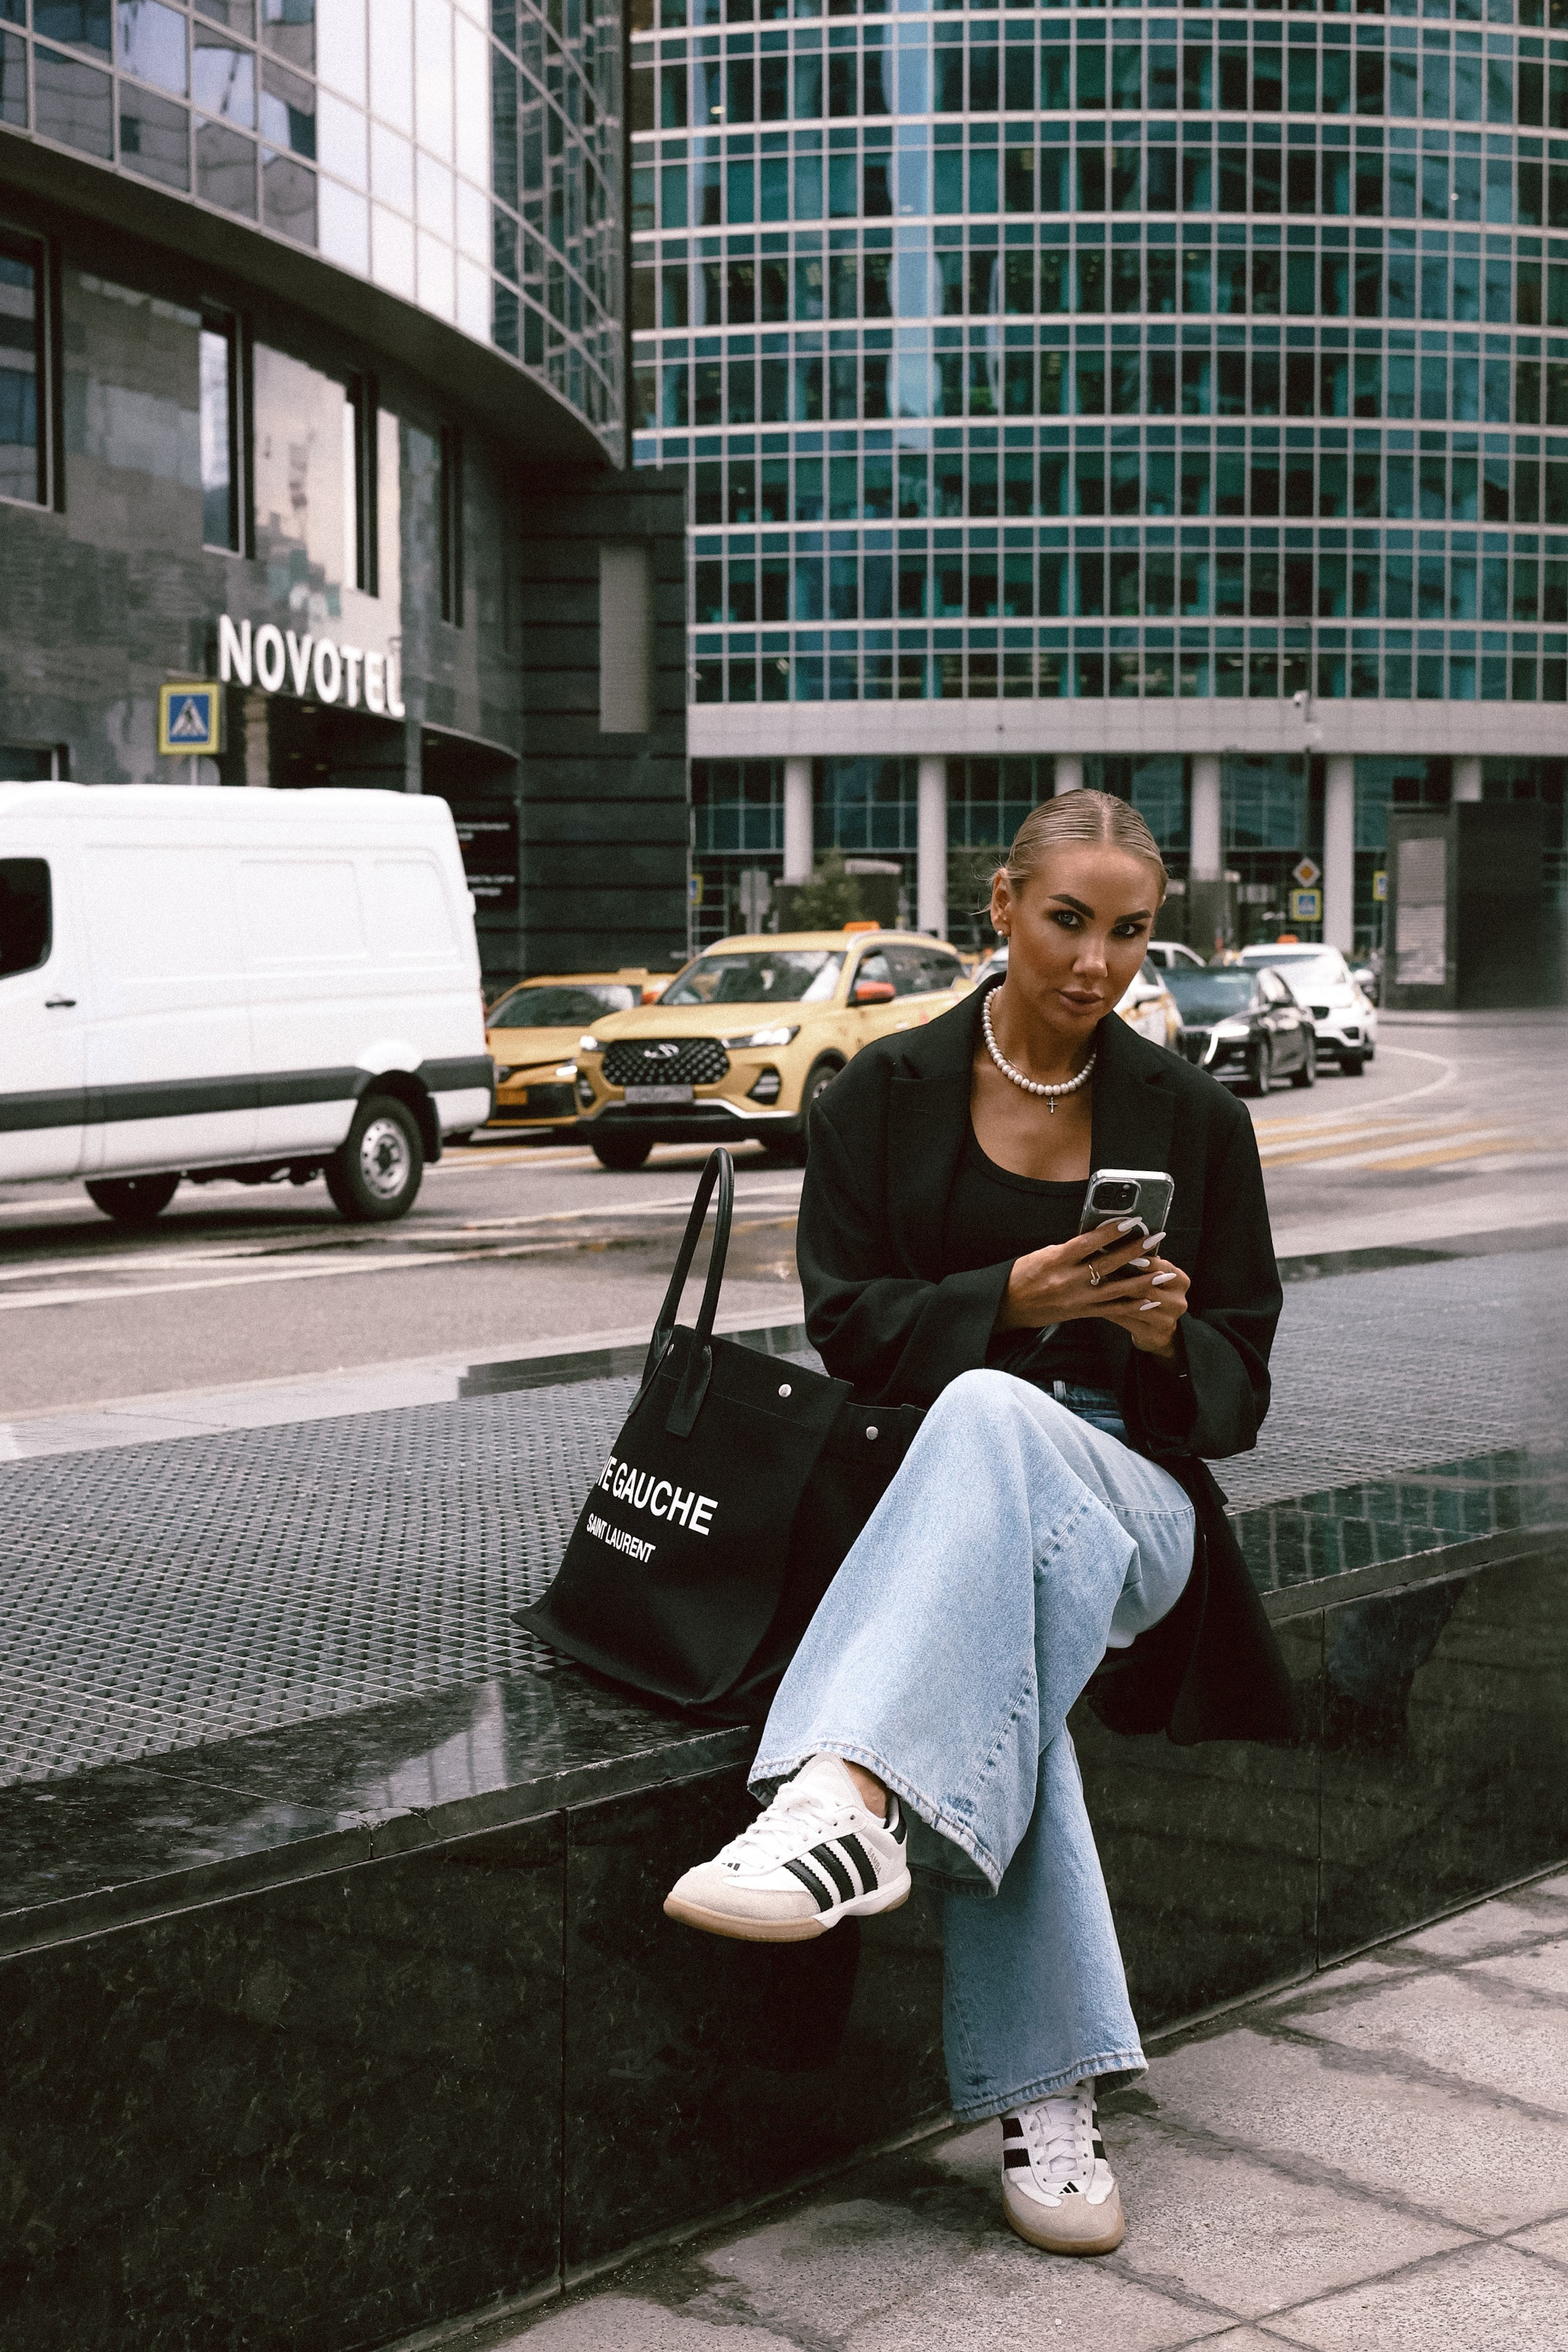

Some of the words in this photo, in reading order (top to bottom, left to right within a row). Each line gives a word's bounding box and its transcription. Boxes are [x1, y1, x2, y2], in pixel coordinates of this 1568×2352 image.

[220, 614, 406, 717] NOVOTEL
[612, 1462, 718, 1536] GAUCHE
[586, 1513, 608, 1540] SAINT
[605, 1524, 656, 1563] LAURENT
[868, 1848, 882, 1875] SAMBA
